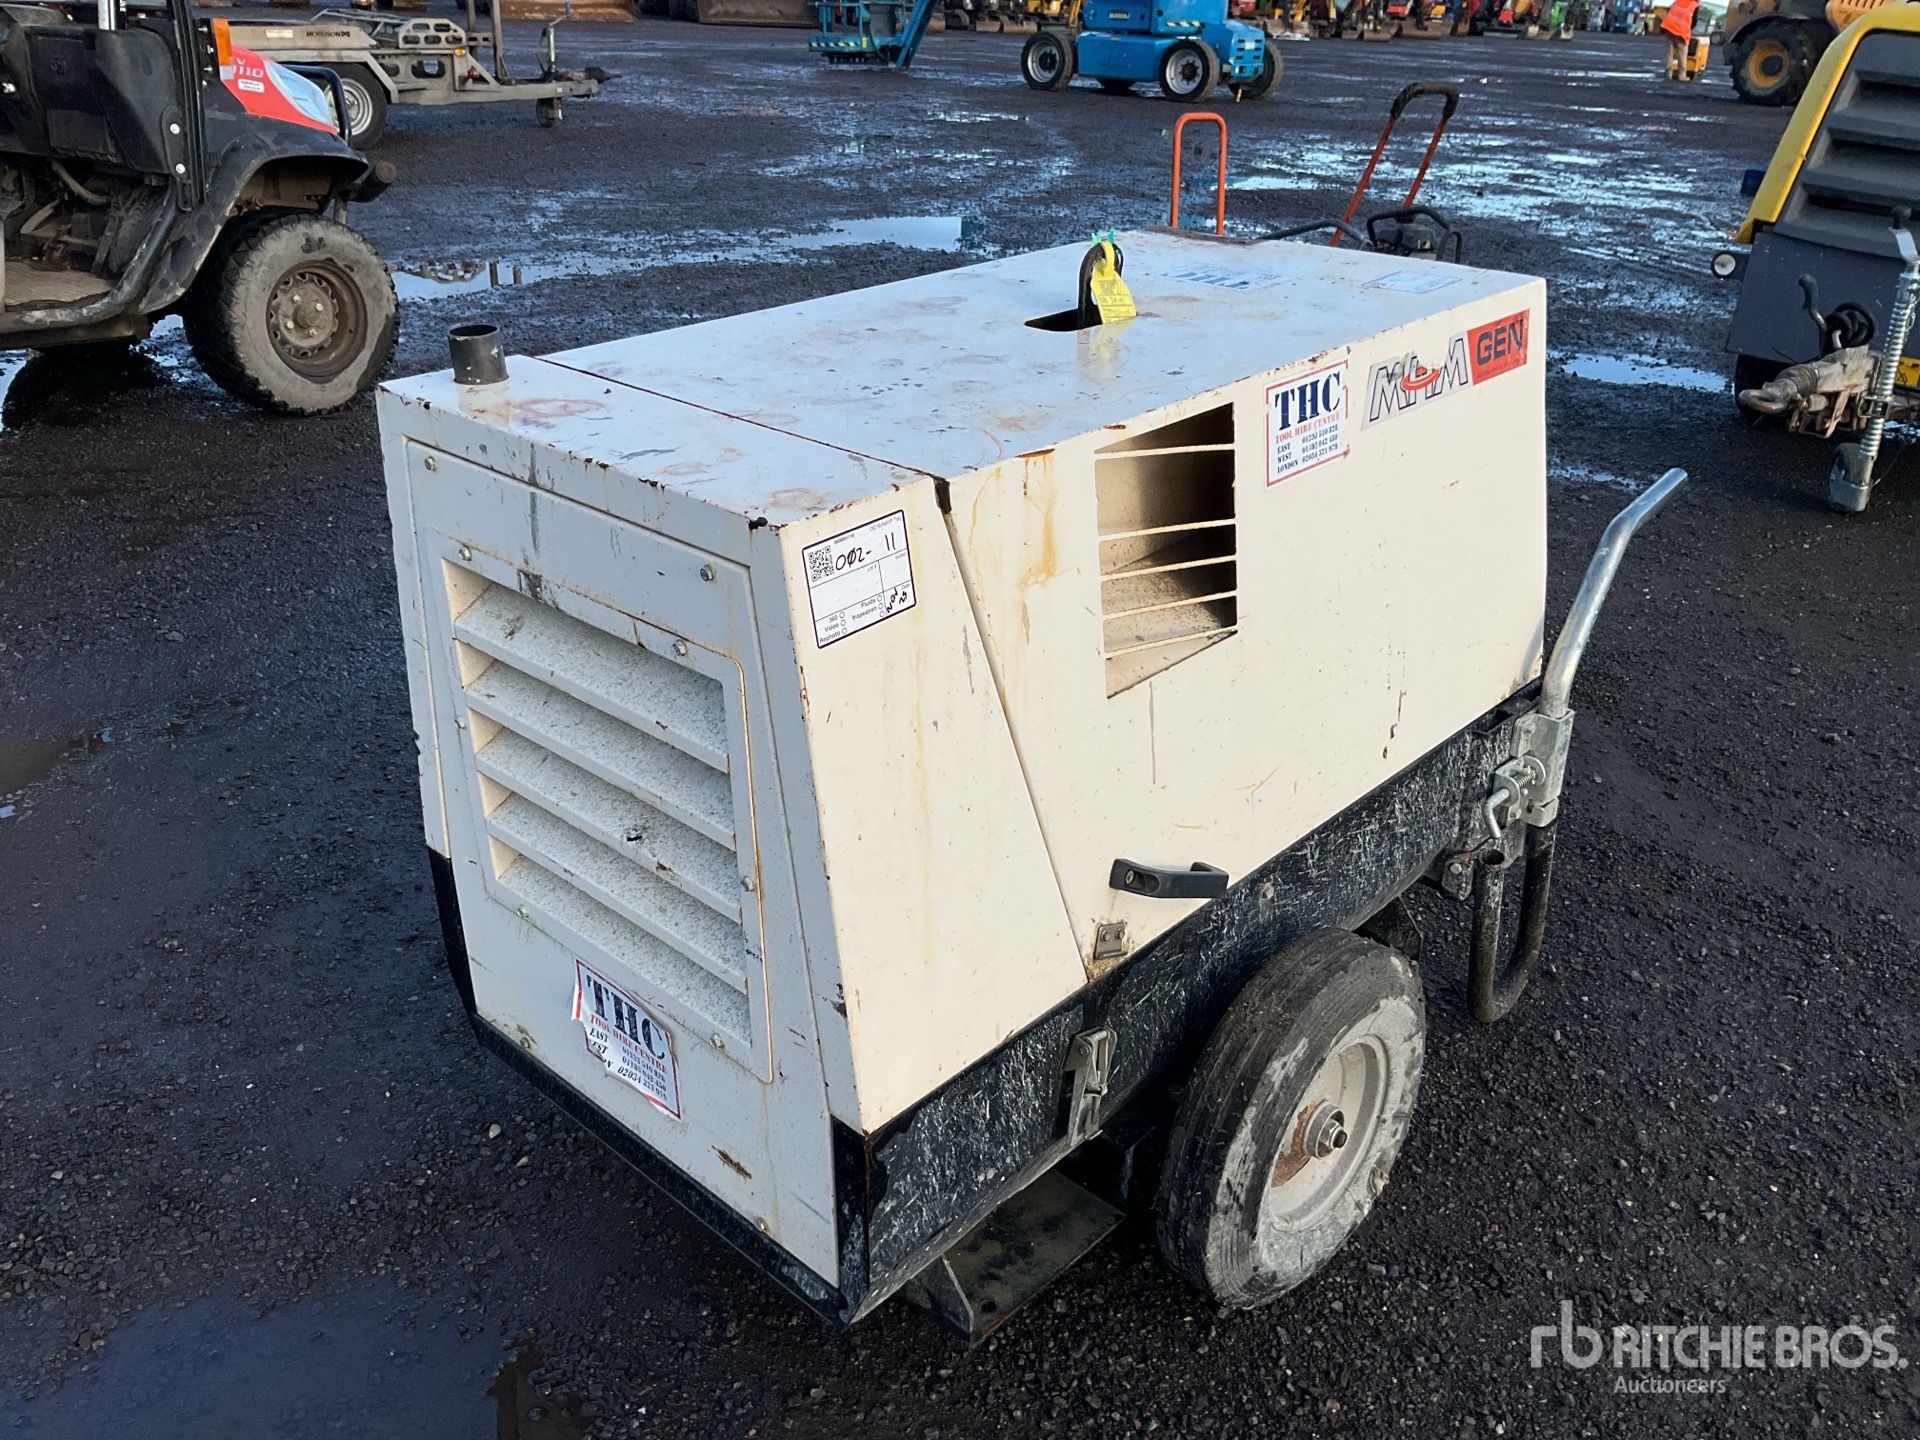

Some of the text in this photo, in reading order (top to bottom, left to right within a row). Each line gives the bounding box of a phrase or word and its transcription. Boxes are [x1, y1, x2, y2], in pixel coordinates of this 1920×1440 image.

[1477, 317, 1524, 366] GEN
[1275, 371, 1340, 431] THC
[1275, 412, 1340, 444] TOOL HIRE CENTRE
[1277, 443, 1291, 454] EAST
[1277, 452, 1292, 463] WEST
[1277, 459, 1299, 474] LONDON
[861, 598, 876, 608] Fluids
[851, 606, 878, 620] Inspection
[824, 622, 840, 632] Video
[819, 630, 841, 643] Rephoto
[586, 974, 665, 1060] THC
[589, 1028, 609, 1043] EAST
[590, 1014, 610, 1032] TOOL
[612, 1028, 633, 1048] HIRE
[634, 1045, 667, 1073] CENTRE
[590, 1040, 609, 1055] EST
